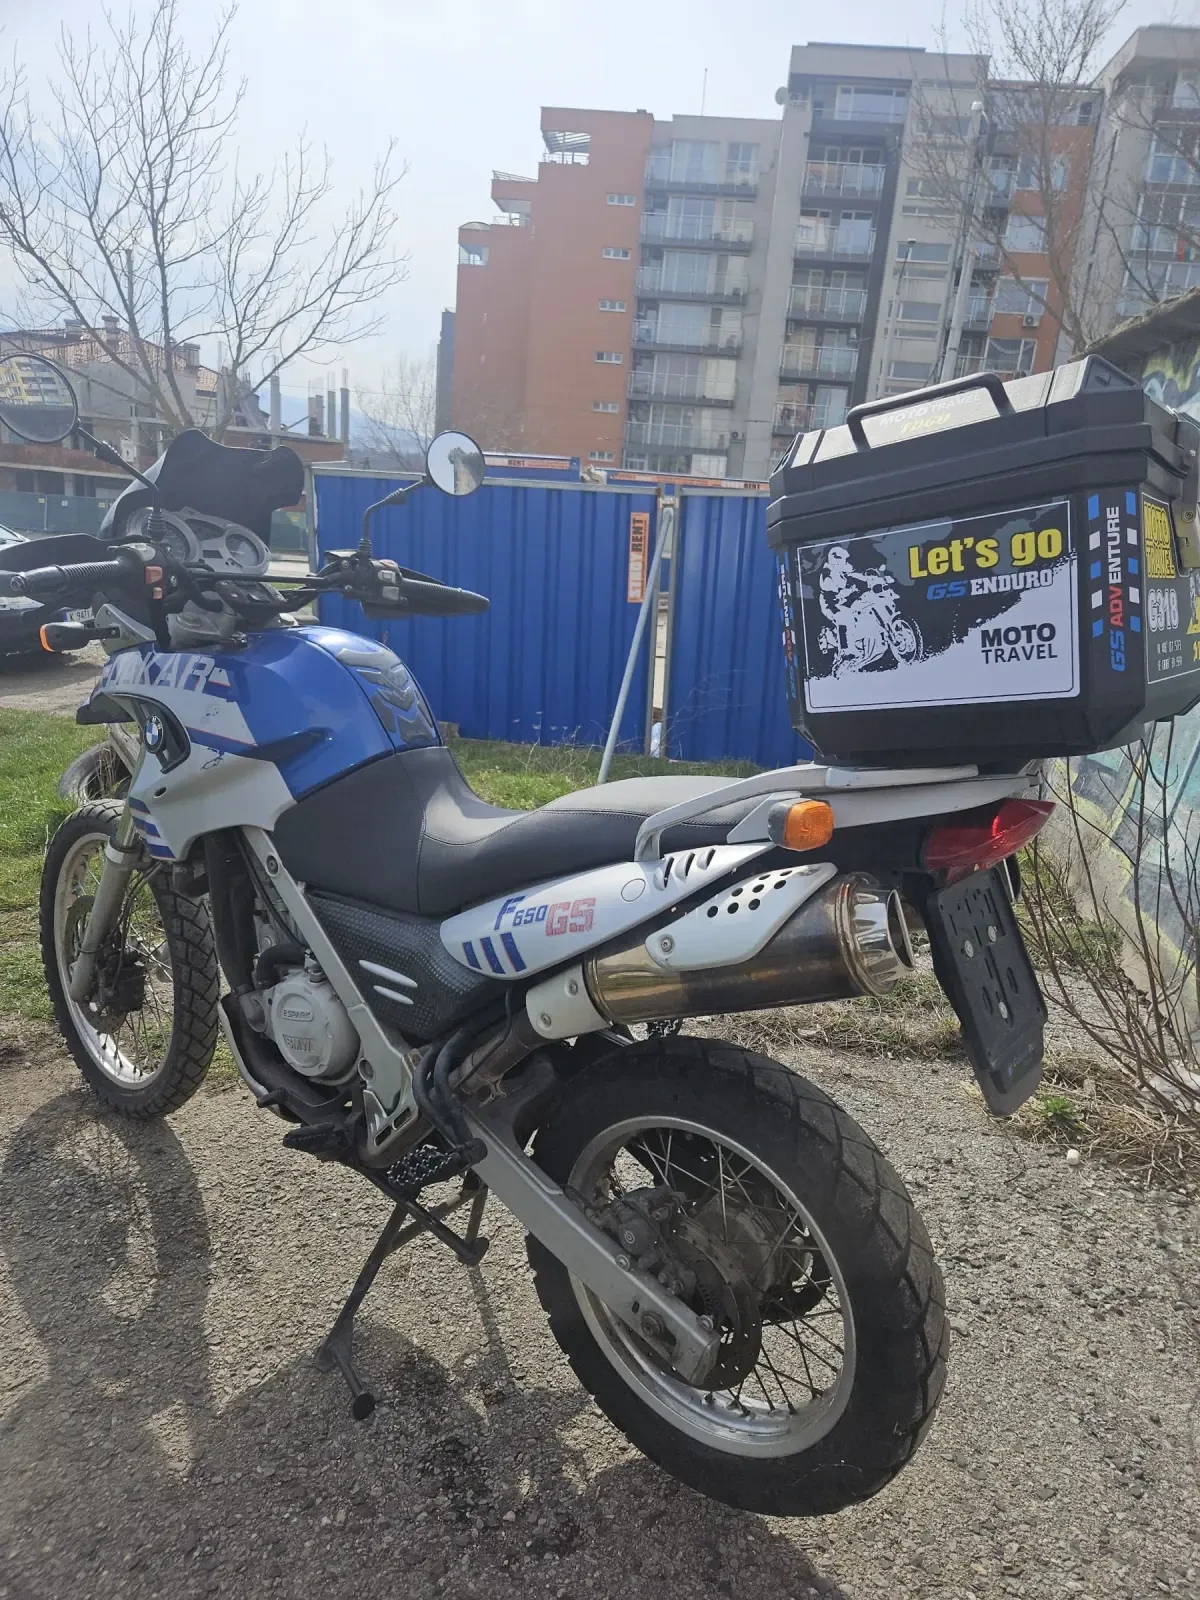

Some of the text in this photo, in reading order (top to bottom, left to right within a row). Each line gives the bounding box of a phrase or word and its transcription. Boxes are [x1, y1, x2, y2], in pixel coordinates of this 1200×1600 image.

[631, 518, 644, 552] RENT
[1143, 501, 1170, 545] MOTO
[908, 528, 1063, 579] Let's go
[926, 568, 1054, 600] GS ENDURO
[1106, 506, 1126, 672] GS ADVENTURE
[980, 622, 1057, 649] MOTO
[981, 643, 1058, 664] TRAVEL
